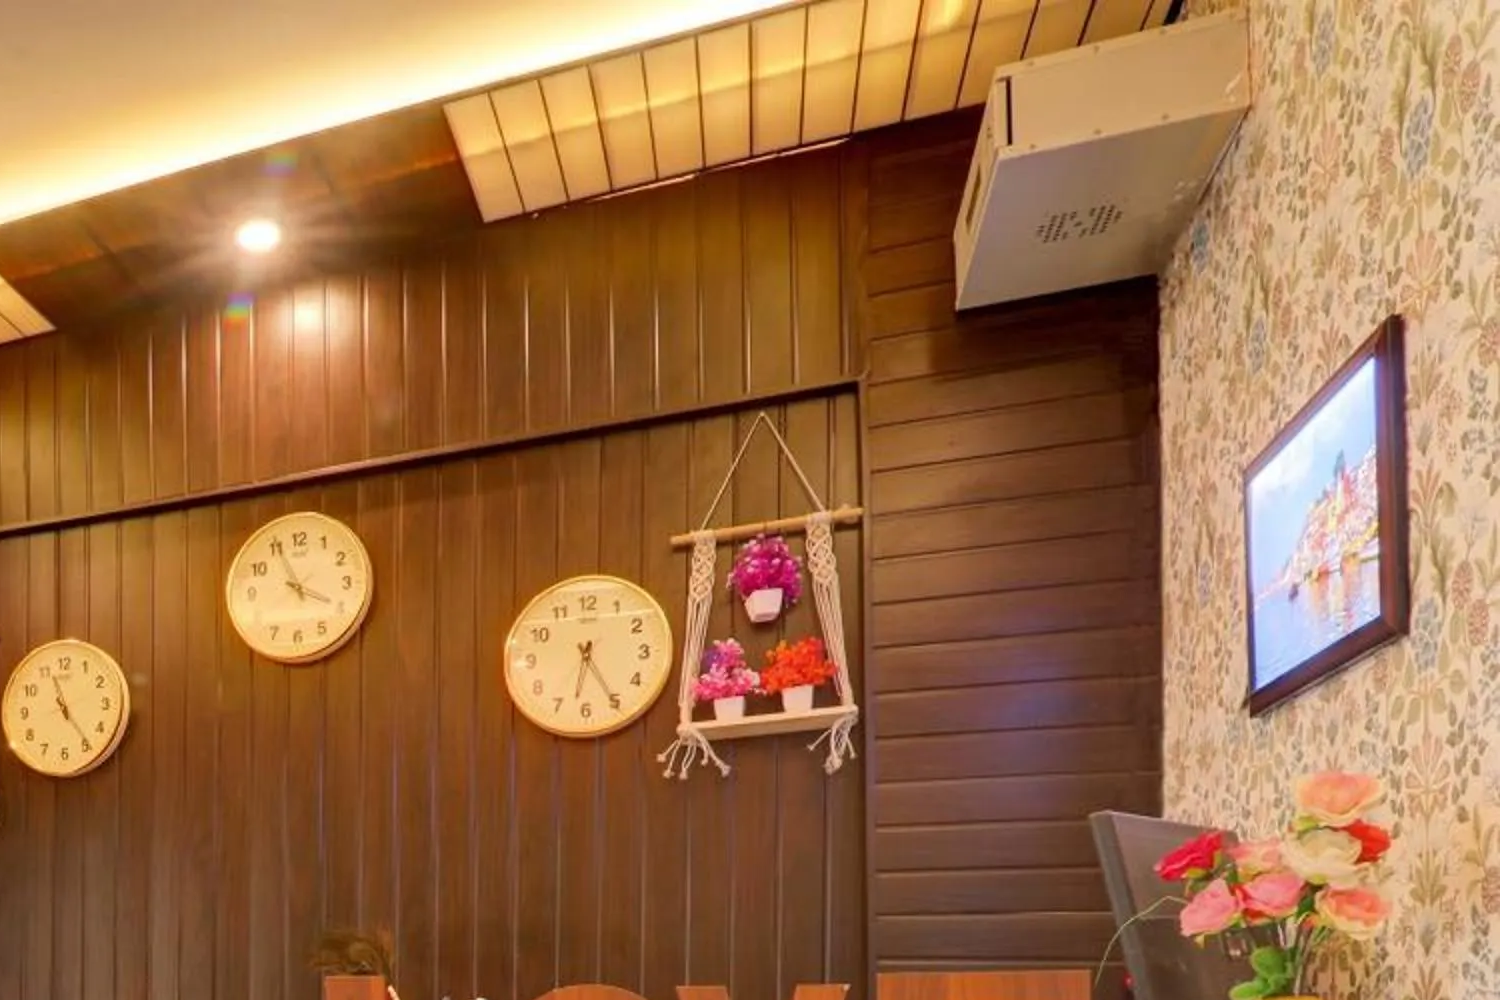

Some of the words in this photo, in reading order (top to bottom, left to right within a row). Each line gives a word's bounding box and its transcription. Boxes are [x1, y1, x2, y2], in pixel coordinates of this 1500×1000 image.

[292, 531, 307, 547] 12
[320, 535, 328, 549] 1
[335, 551, 346, 566] 2
[251, 561, 268, 576] 10
[342, 575, 352, 590] 3
[579, 595, 597, 611] 12
[612, 600, 620, 614] 1
[552, 605, 567, 619] 11
[269, 625, 280, 640] 7
[317, 621, 327, 635] 5
[630, 618, 643, 634] 2
[530, 627, 549, 643] 10
[638, 644, 650, 660] 3
[59, 656, 71, 671] 12
[82, 660, 88, 673] 1
[525, 653, 537, 670] 9
[95, 675, 105, 688] 2
[629, 672, 641, 687] 4
[24, 683, 37, 697] 10
[532, 679, 543, 696] 8
[553, 697, 564, 714] 7
[609, 693, 621, 710] 5
[20, 706, 29, 720] 9
[580, 703, 592, 718] 6
[40, 743, 49, 756] 7
